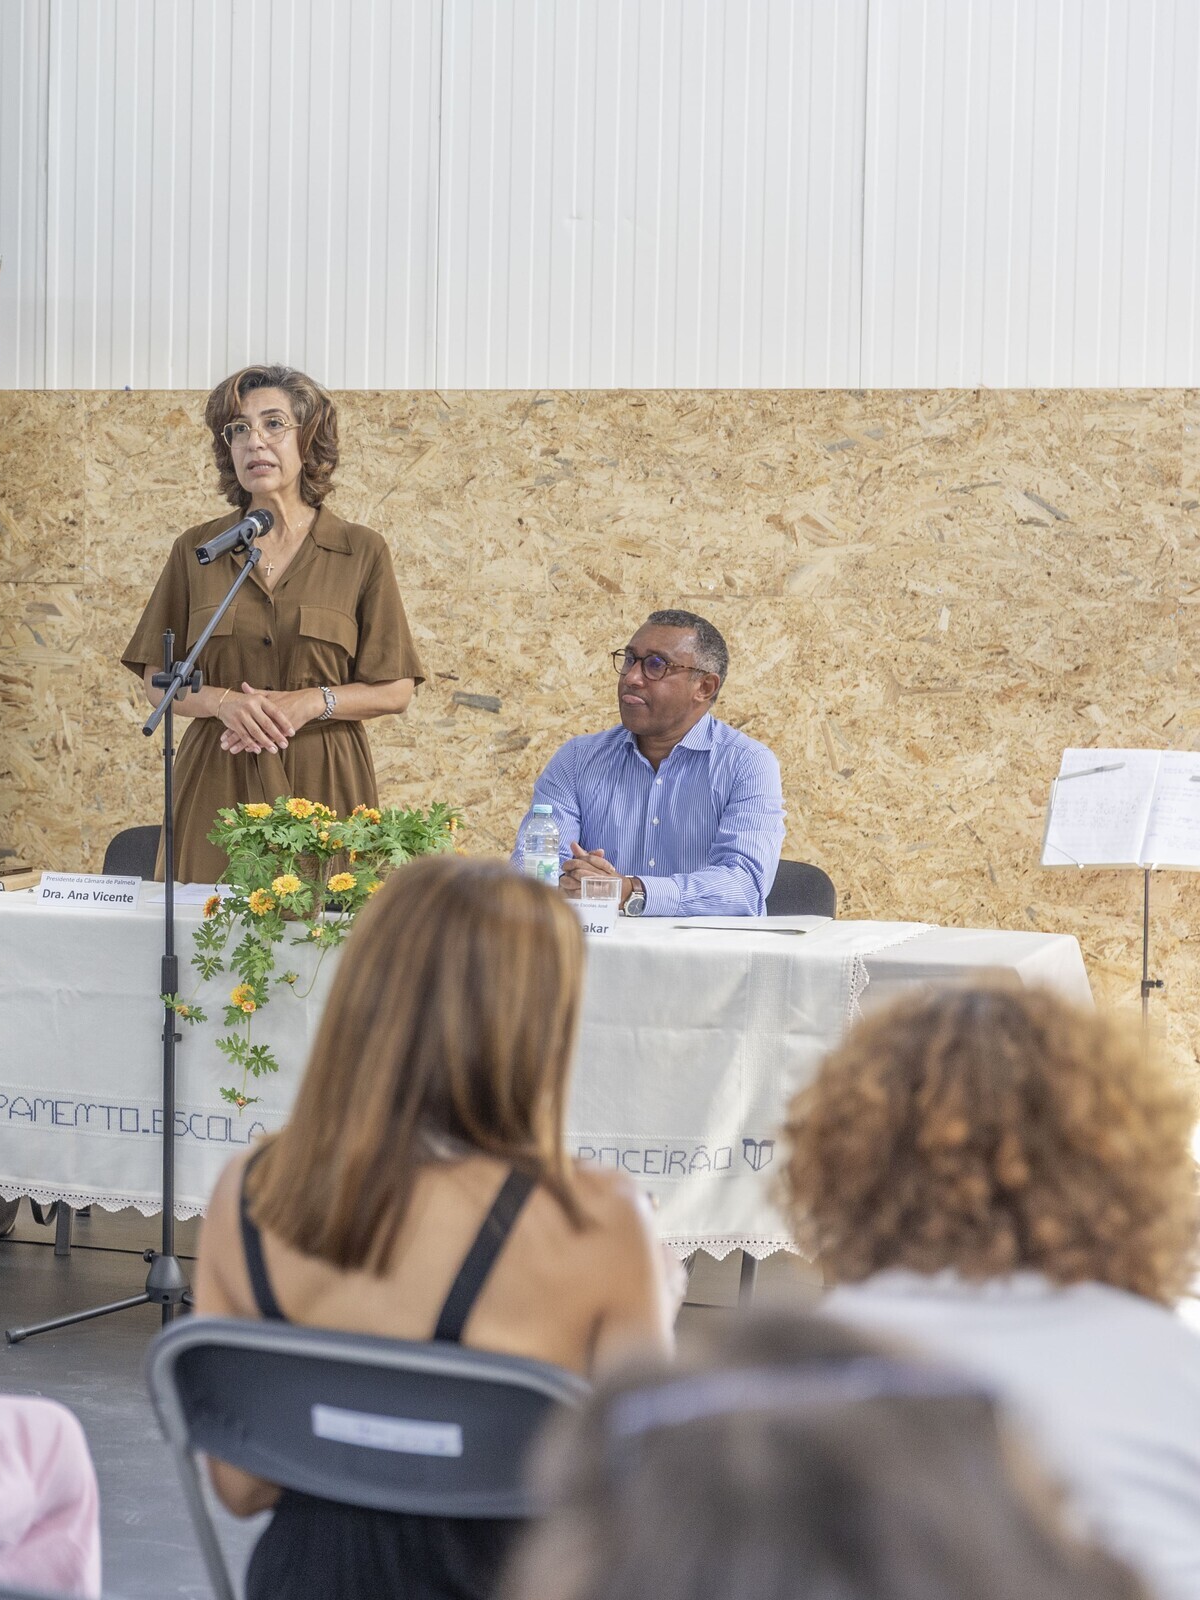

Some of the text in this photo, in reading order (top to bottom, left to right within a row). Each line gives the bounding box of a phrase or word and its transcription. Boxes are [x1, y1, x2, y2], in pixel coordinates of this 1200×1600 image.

[46, 875, 74, 883] Presidente
[42, 889, 134, 903] Dra. Ana Vicente
[582, 922, 609, 933] akar
